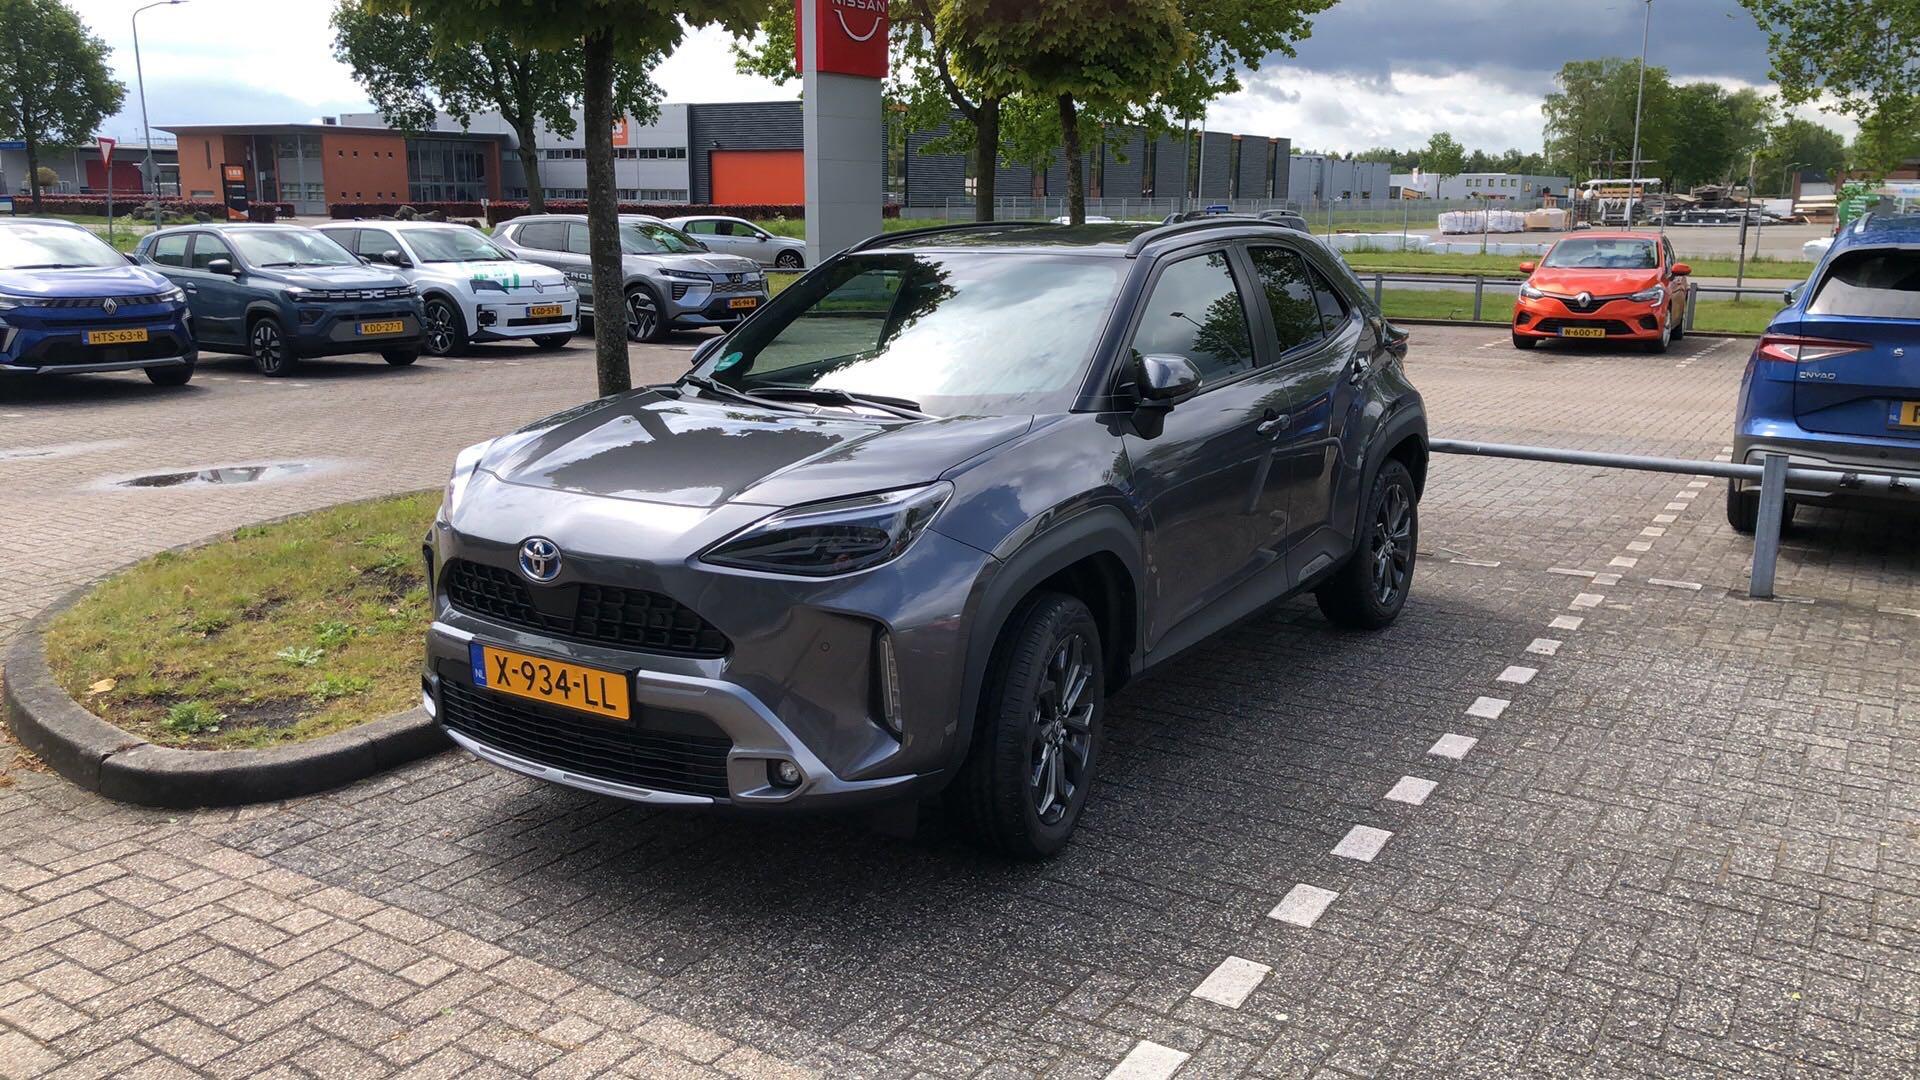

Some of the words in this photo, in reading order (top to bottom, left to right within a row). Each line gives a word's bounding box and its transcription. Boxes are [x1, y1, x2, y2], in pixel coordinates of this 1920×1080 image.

[364, 322, 402, 333] KDD-27-T
[1564, 329, 1603, 337] N-600-TJ
[92, 331, 144, 342] HTS-63-R
[474, 668, 486, 680] NL
[495, 654, 617, 711] X-934-LL
